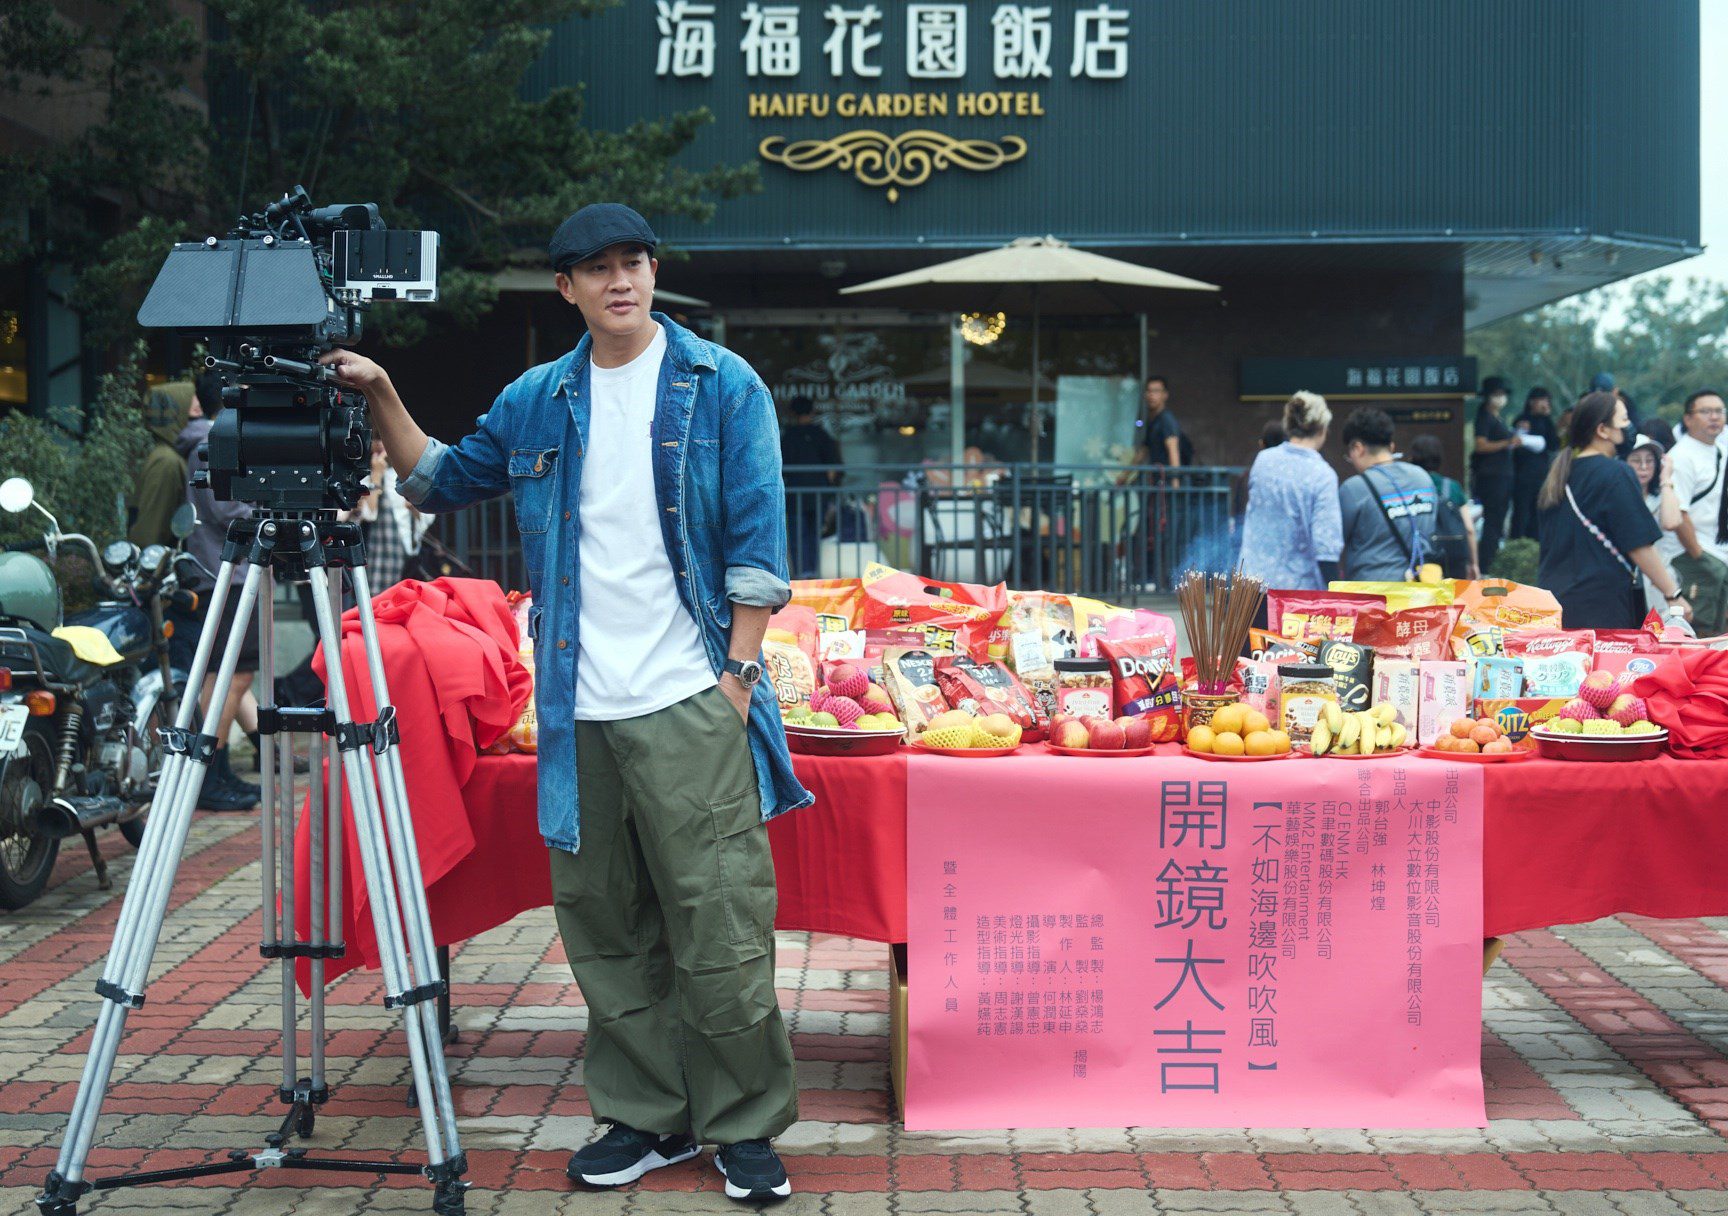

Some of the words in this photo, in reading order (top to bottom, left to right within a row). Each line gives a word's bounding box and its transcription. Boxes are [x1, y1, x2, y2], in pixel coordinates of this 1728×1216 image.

[655, 0, 1130, 79] 海福花園飯店
[748, 93, 829, 117] HAIFU
[836, 93, 949, 117] GARDEN
[957, 92, 1045, 116] HOTEL
[1396, 620, 1429, 638] 酵母
[1526, 637, 1575, 653] Kellogg's
[1327, 648, 1360, 666] Lay's
[1494, 713, 1530, 736] RITZ
[1337, 801, 1352, 817] CJ
[1393, 768, 1407, 810] 出品人
[1301, 801, 1316, 838] MM2
[1337, 822, 1350, 855] ENM
[1372, 800, 1389, 847] 郭台強
[1281, 801, 1301, 960] 華藝娛樂股份有限公司
[1335, 861, 1348, 880] HK
[1424, 798, 1441, 928] 中影股份有限公司
[1298, 843, 1314, 941] Entertainment
[1371, 863, 1386, 911] 林坤煌
[1406, 799, 1424, 1027] 大川大立數位影音股份有限公司
[943, 860, 959, 1012] 暨全體工作人員
[1153, 780, 1229, 1094] 開鏡大吉
